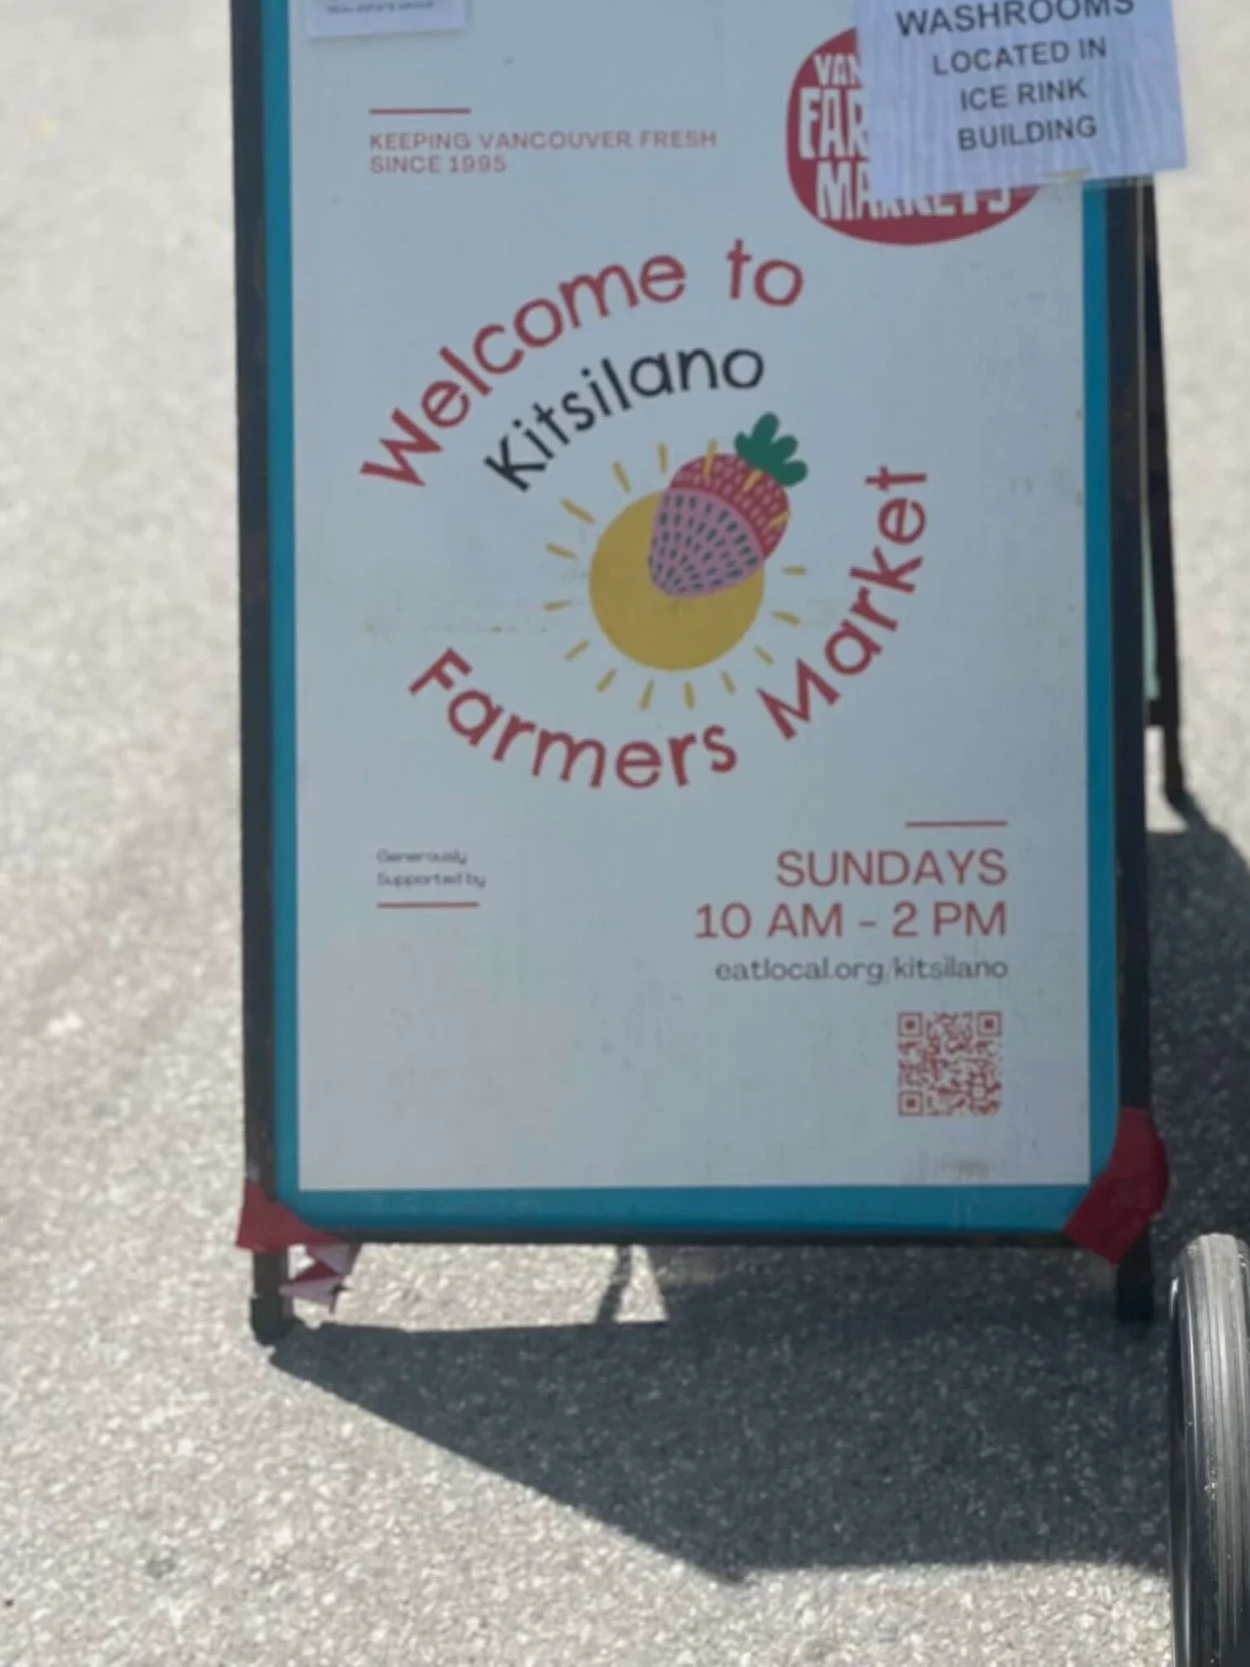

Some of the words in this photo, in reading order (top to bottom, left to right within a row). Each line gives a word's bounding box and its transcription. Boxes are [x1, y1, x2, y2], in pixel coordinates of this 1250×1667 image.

[933, 40, 1070, 76] LOCATED
[1079, 36, 1107, 60] IN
[960, 85, 1008, 111] ICE
[1018, 77, 1088, 106] RINK
[370, 132, 471, 151] KEEPING
[480, 130, 632, 150] VANCOUVER
[641, 129, 717, 148] FRESH
[957, 115, 1098, 151] BUILDING
[369, 155, 441, 174] SINCE
[449, 154, 507, 174] 1995
[361, 254, 687, 488] Welcome
[727, 239, 805, 307] to
[483, 347, 765, 493] Kitsilano
[408, 648, 738, 789] Farmers
[756, 465, 927, 741] Market
[775, 848, 1008, 888] SUNDAYS
[695, 902, 752, 939] 10
[767, 902, 843, 938] AM
[892, 900, 919, 938] 2
[933, 900, 1007, 938] PM
